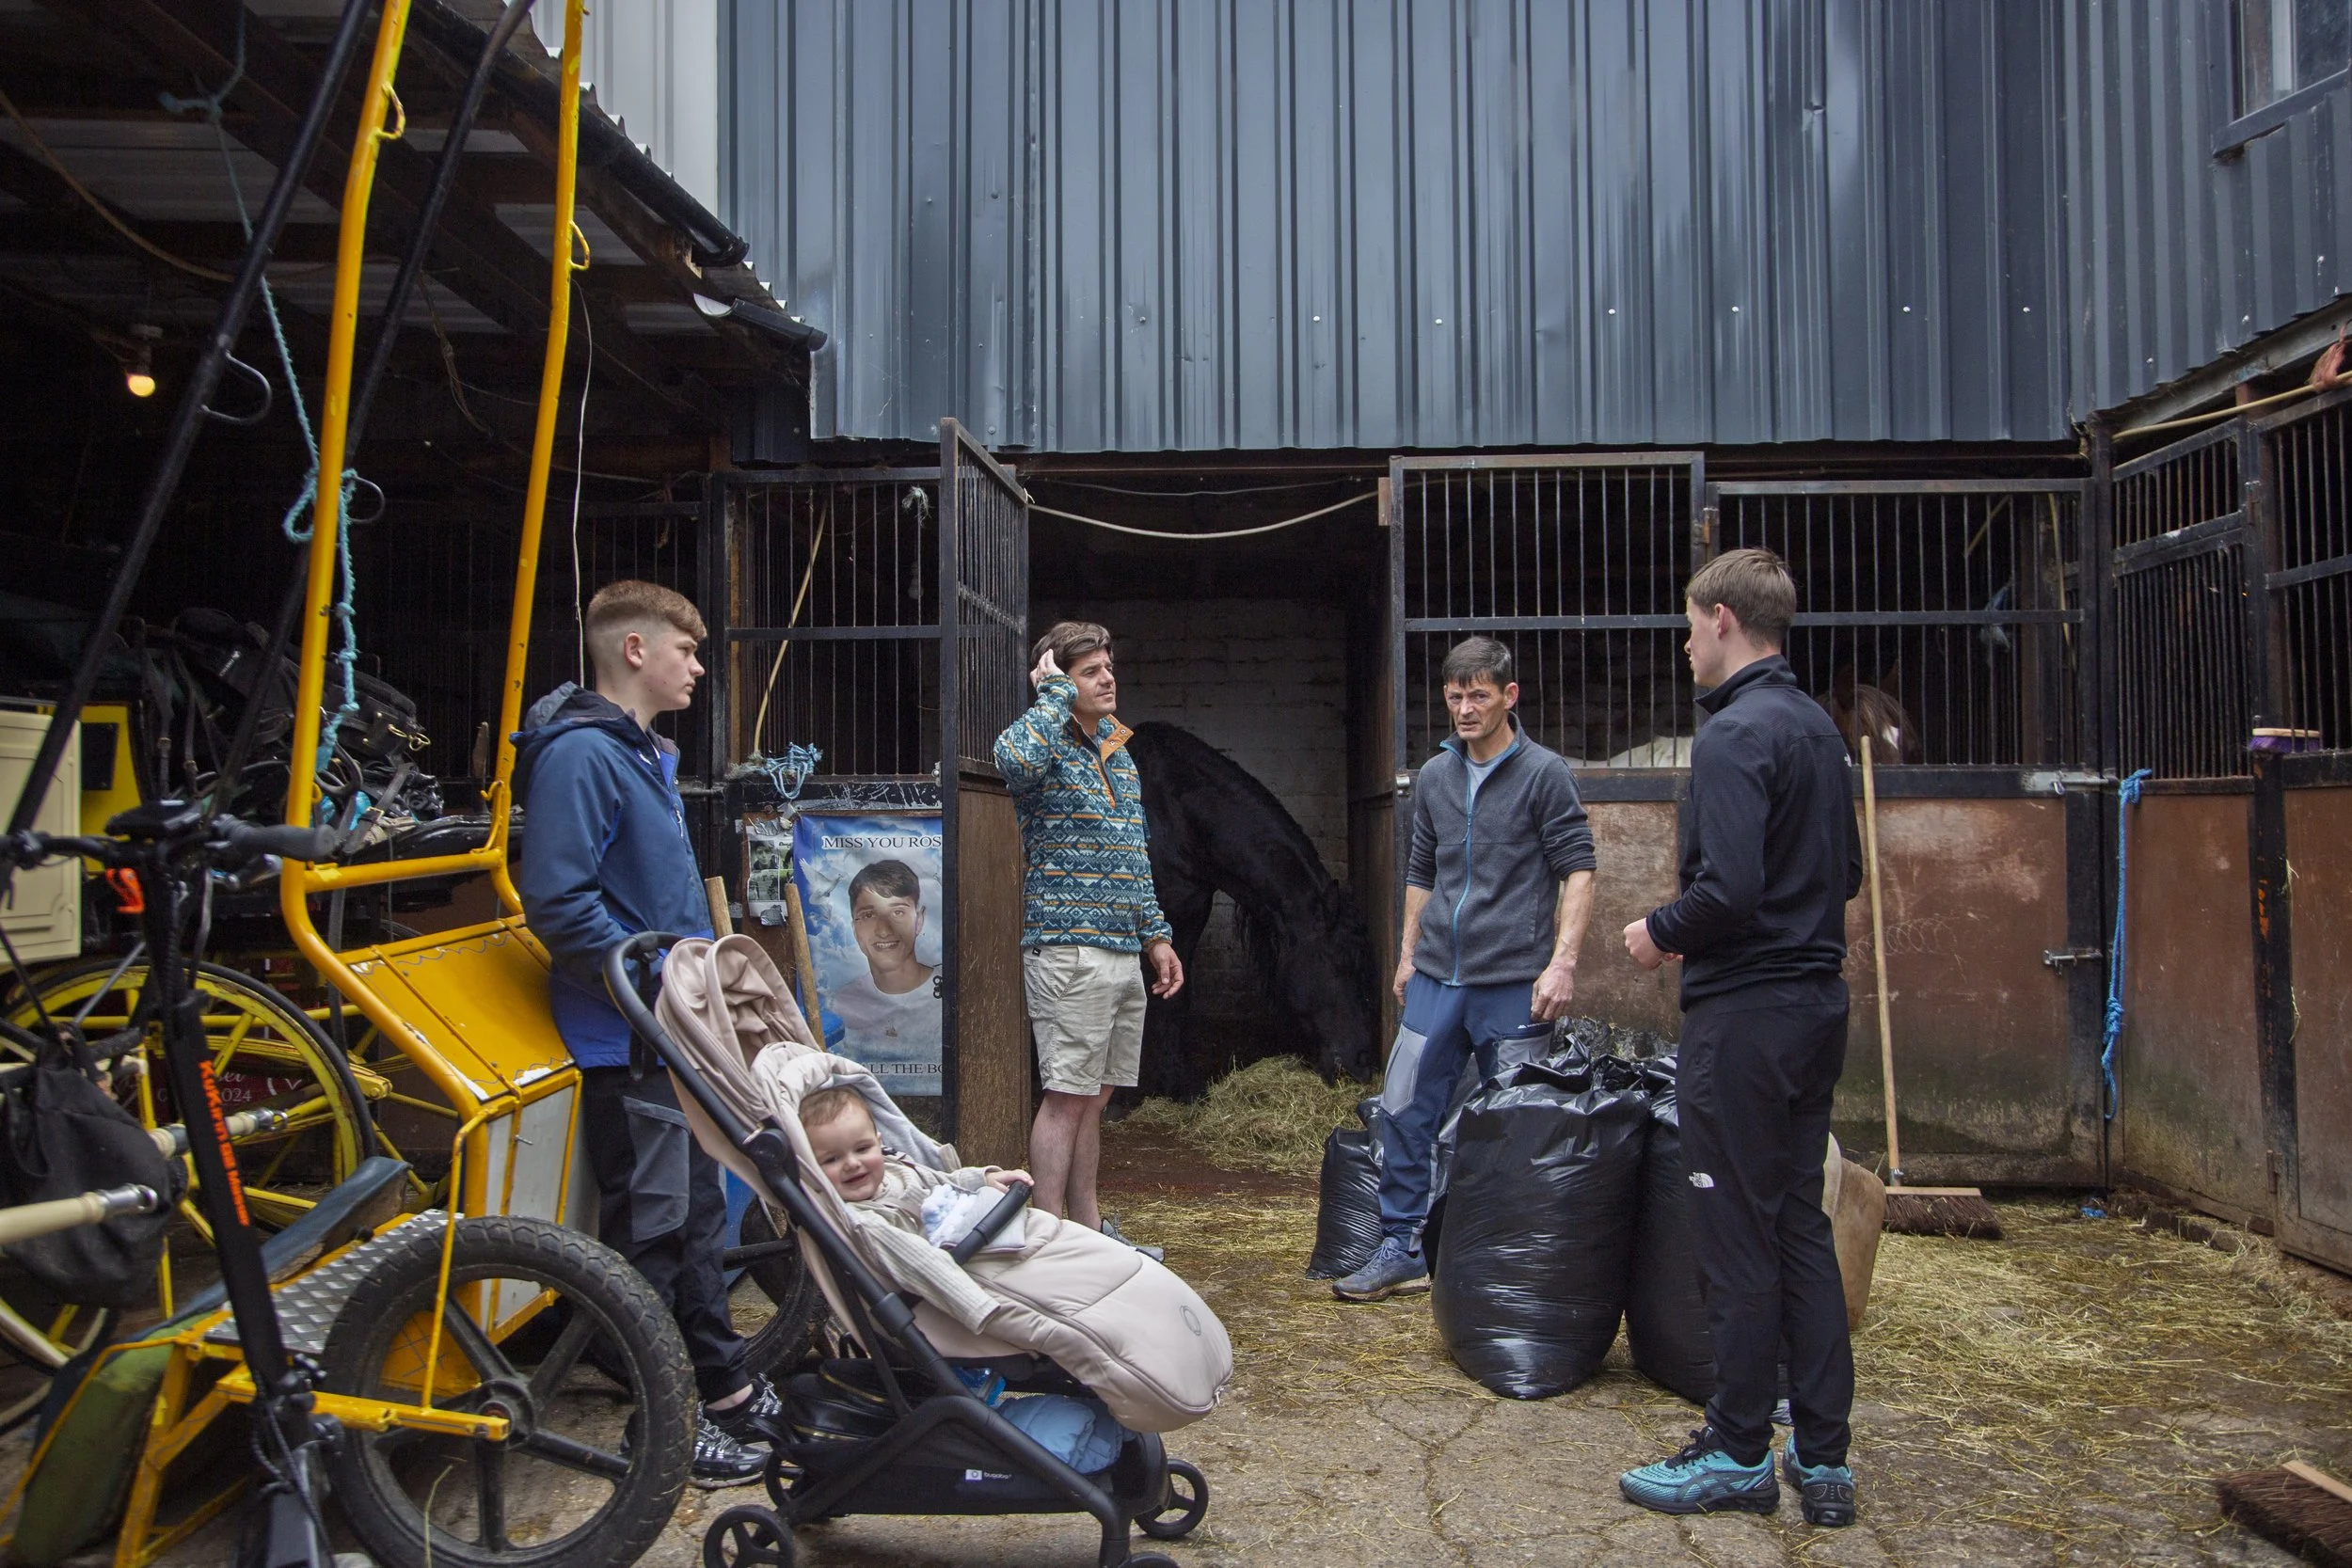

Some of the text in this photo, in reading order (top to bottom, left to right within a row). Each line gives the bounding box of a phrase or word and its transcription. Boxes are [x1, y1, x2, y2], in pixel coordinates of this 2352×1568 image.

[824, 837, 863, 848] MISS
[867, 837, 904, 848] YOU
[863, 1063, 889, 1074] LL
[892, 1063, 923, 1074] THE
[221, 1087, 253, 1102] 024
